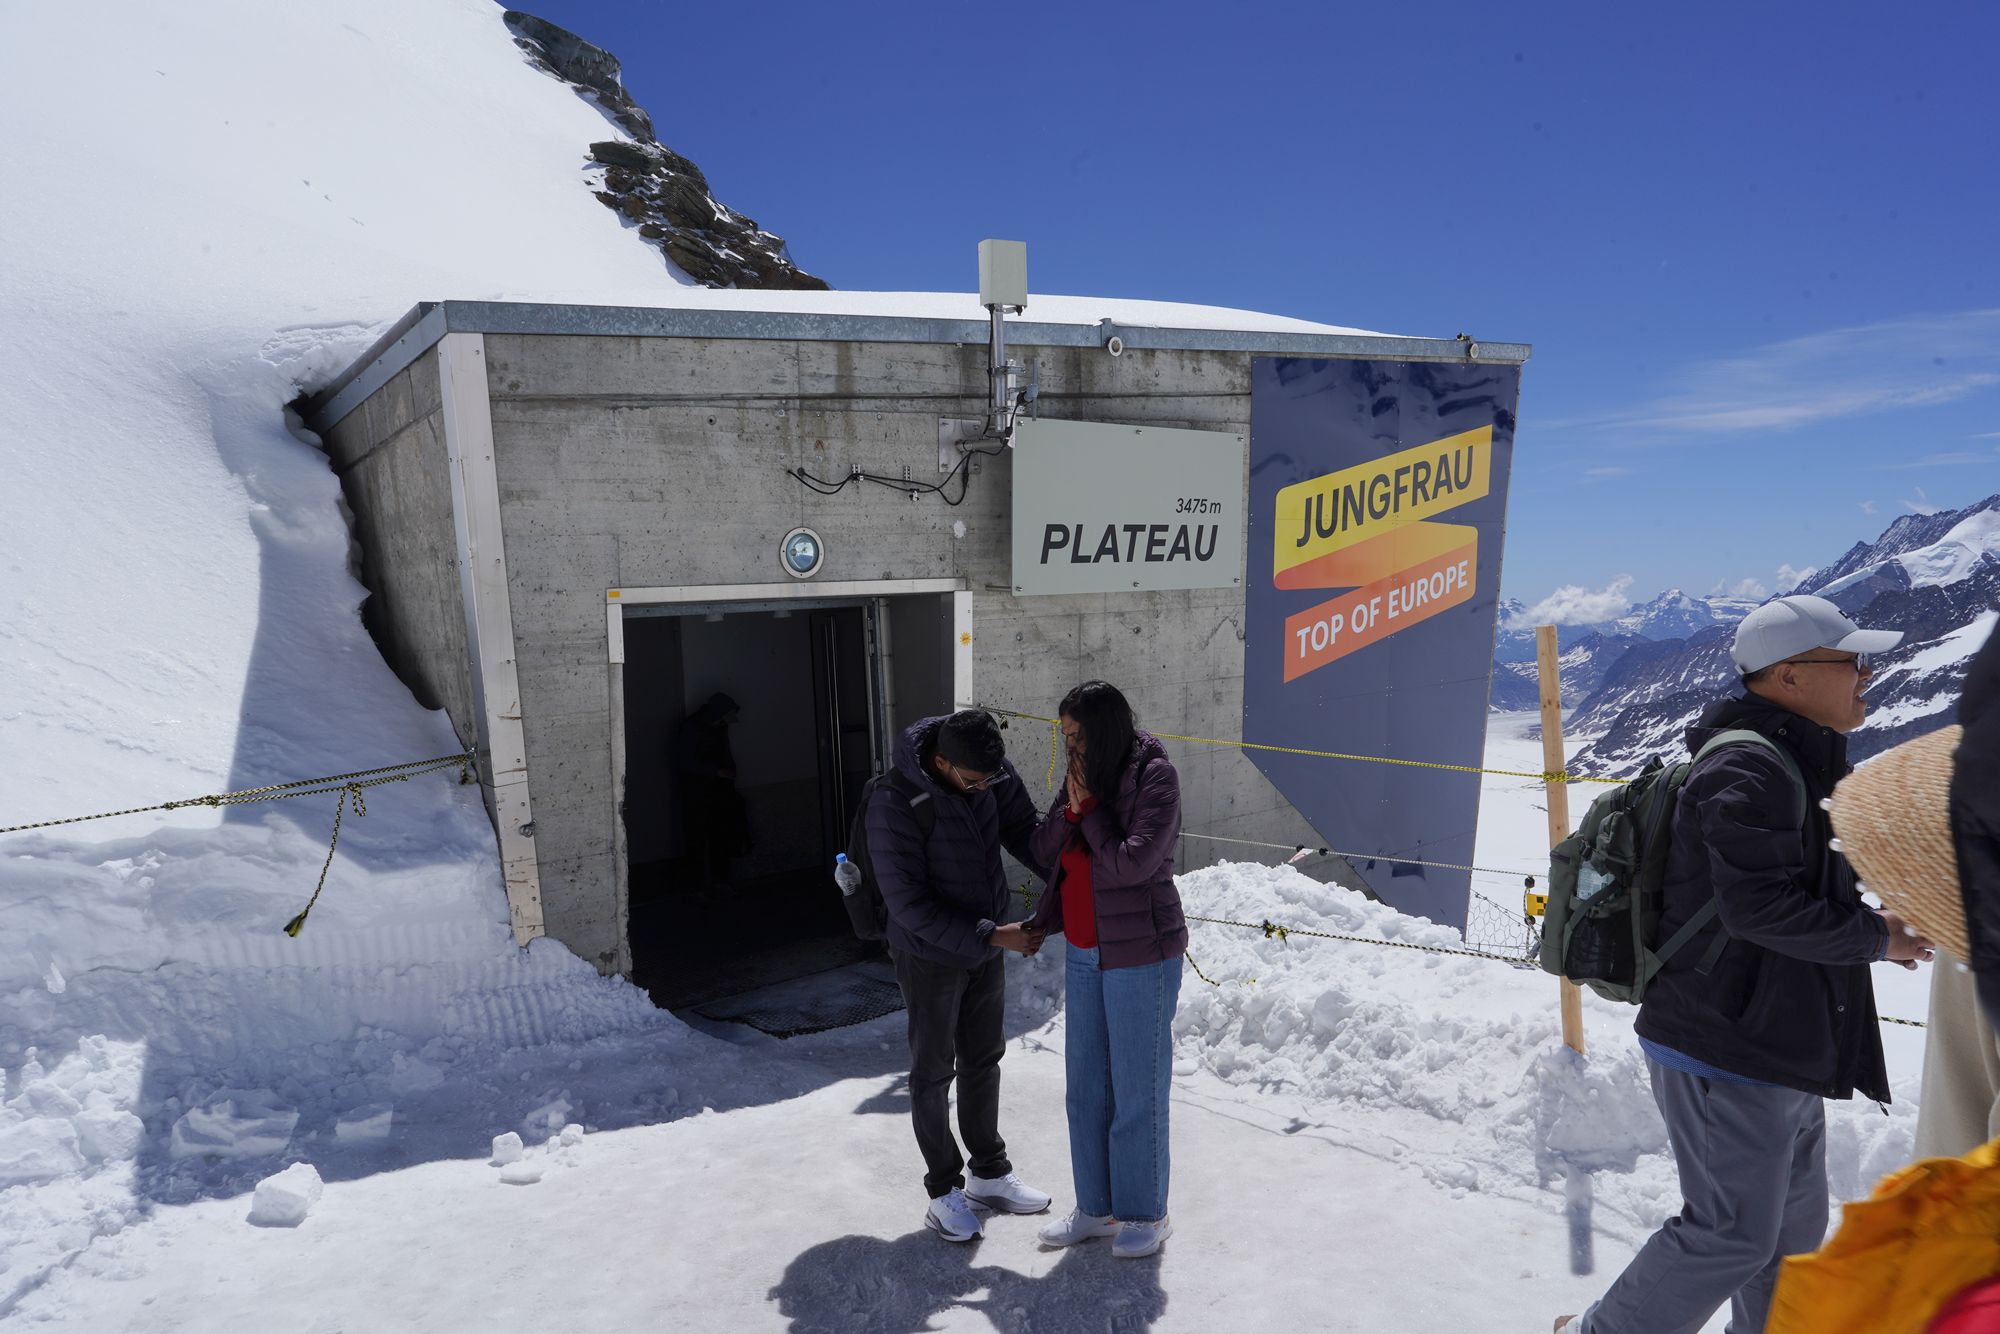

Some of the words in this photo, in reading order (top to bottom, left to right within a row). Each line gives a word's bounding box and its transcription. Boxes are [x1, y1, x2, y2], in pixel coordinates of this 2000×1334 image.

[1175, 497, 1208, 514] 3475
[1296, 445, 1474, 548] JUNGFRAU
[1040, 524, 1219, 564] PLATEAU
[1296, 613, 1344, 659] TOP
[1351, 596, 1382, 634] OF
[1388, 560, 1469, 619] EUROPE
